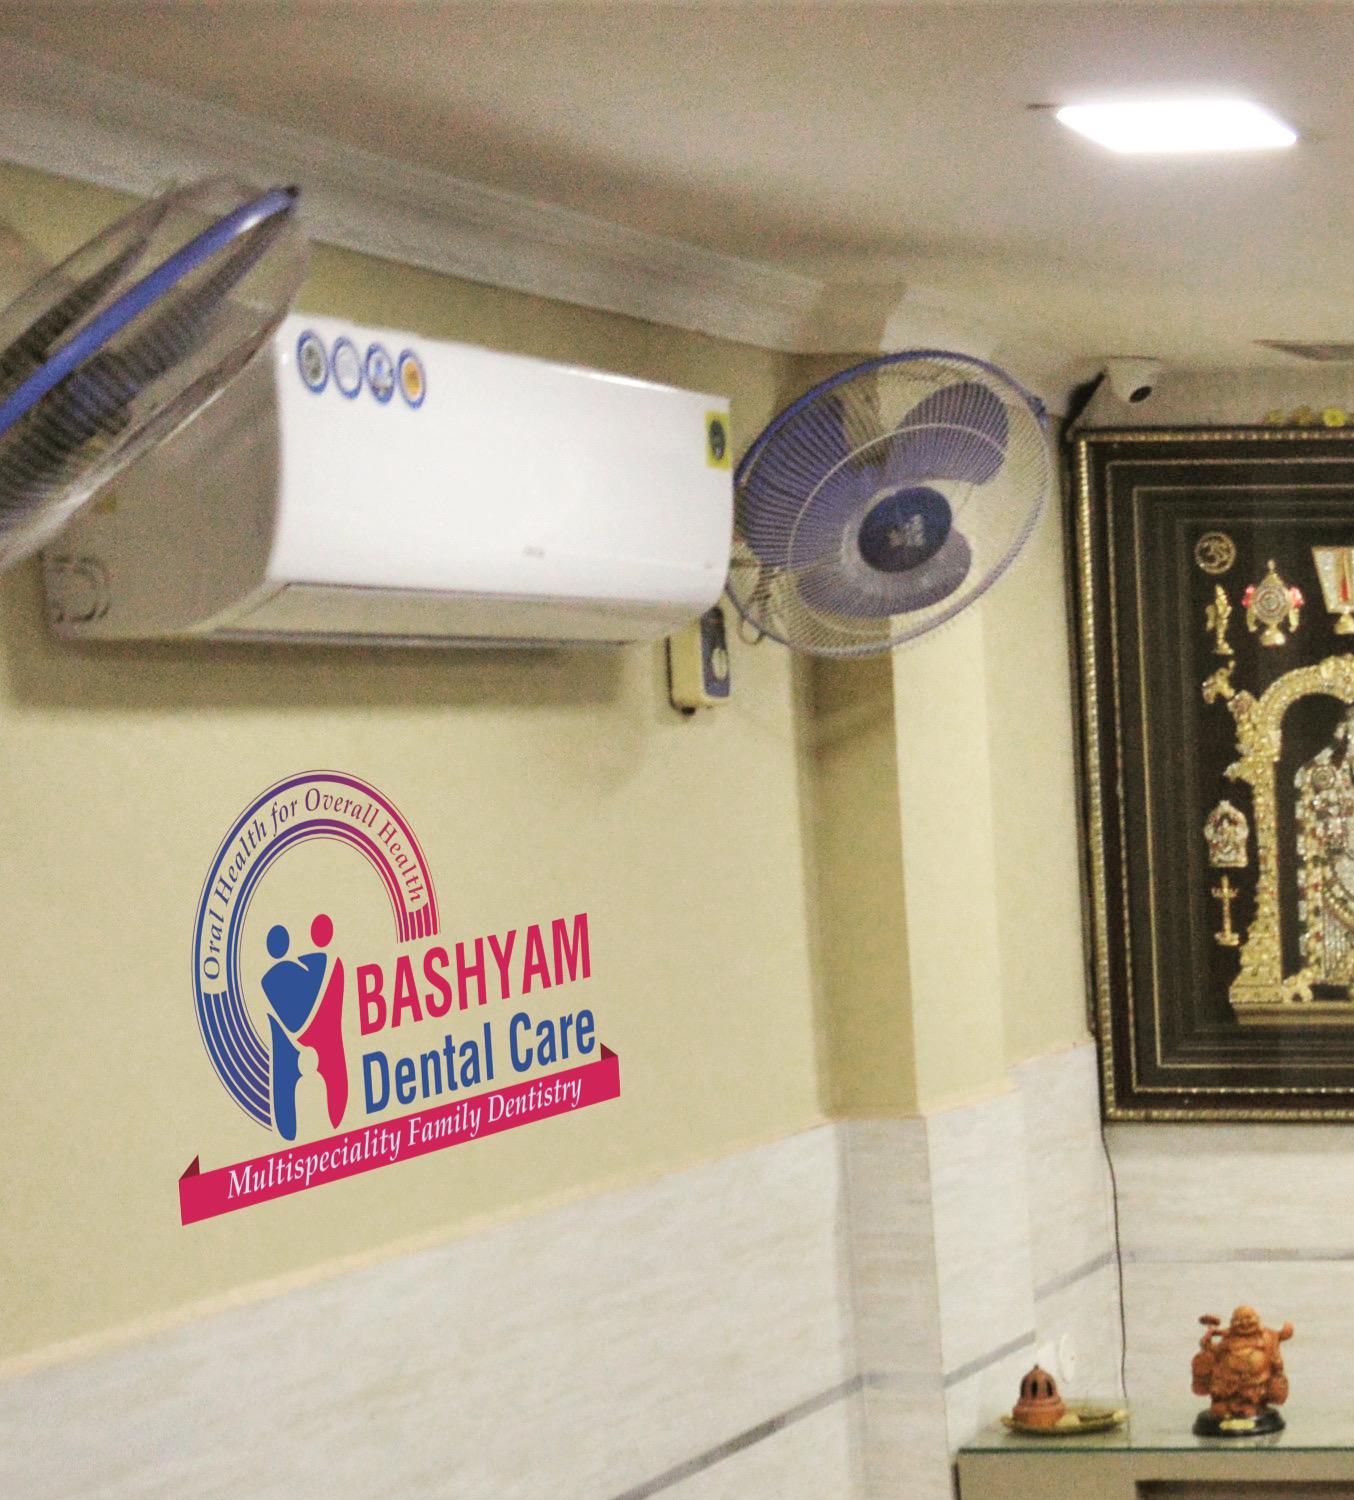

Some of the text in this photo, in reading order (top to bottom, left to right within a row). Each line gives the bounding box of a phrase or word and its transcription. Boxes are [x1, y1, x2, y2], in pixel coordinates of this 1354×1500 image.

[203, 788, 424, 980] Oral Health for Overall Health
[356, 912, 592, 1036] BASHYAM
[362, 1009, 596, 1114] Dental Care
[227, 1076, 583, 1199] Multispeciality Family Dentistry
